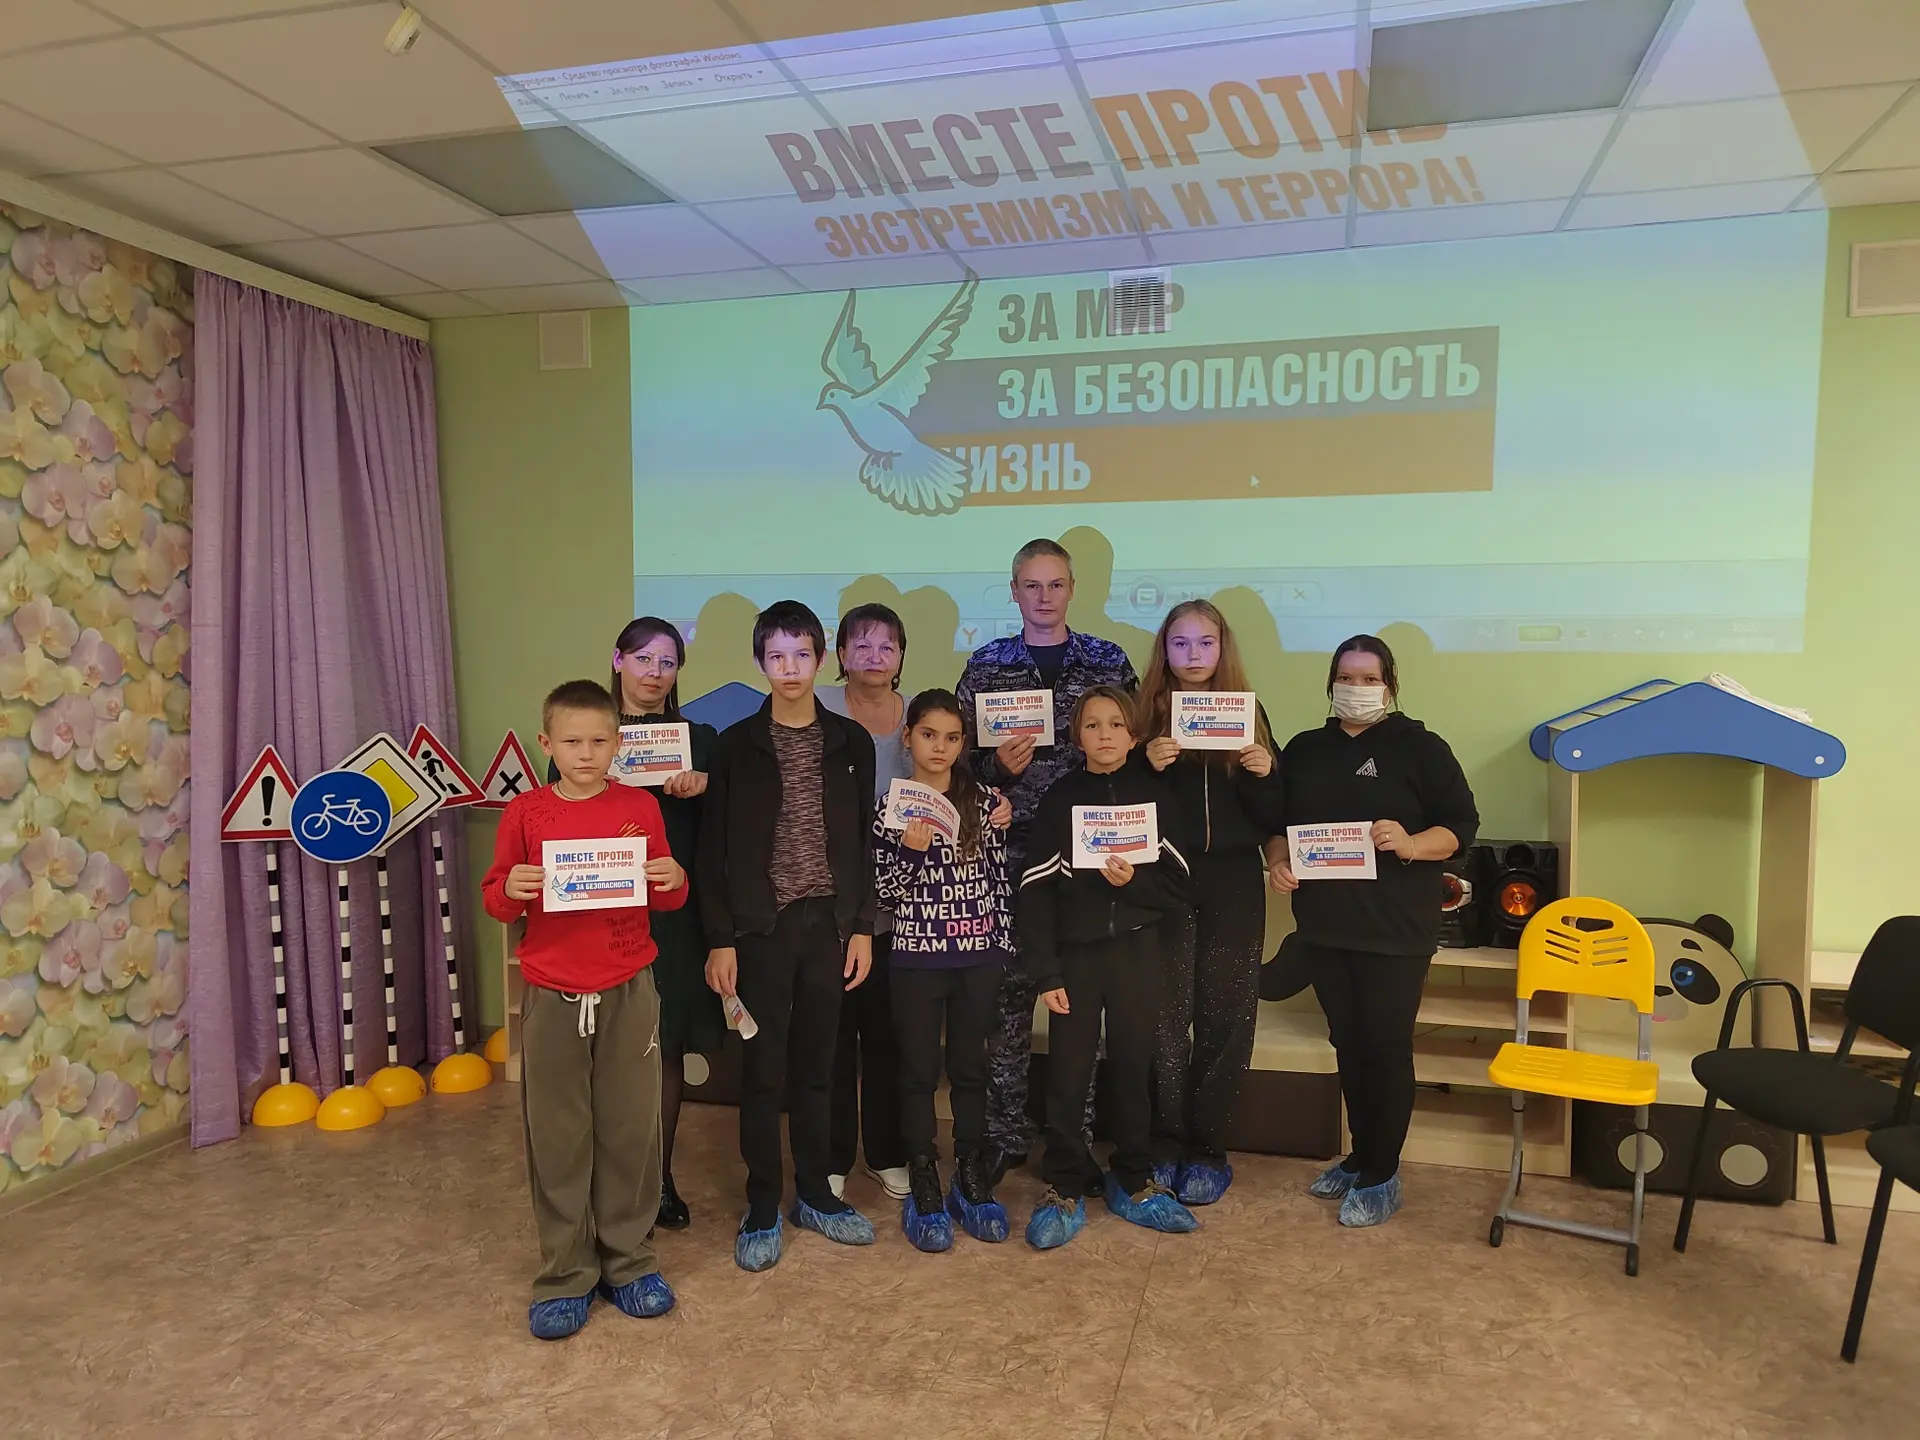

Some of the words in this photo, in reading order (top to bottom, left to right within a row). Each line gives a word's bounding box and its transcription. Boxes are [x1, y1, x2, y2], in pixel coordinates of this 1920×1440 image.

[562, 68, 601, 82] Средство
[649, 56, 701, 71] фотографий
[703, 52, 741, 63] Windows
[714, 71, 753, 83] Открыть
[765, 103, 1094, 203] ВМЕСТЕ
[814, 187, 1172, 258] ЭКСТРЕМИЗМА
[1171, 181, 1220, 228] И
[1218, 156, 1485, 223] ТЕРРОРА!
[998, 291, 1059, 344] ЗА
[998, 367, 1058, 419] ЗА
[1074, 343, 1481, 416] БЕЗОПАСНОСТЬ
[940, 441, 1091, 493] ИЗНЬ
[985, 697, 1014, 706] ВМЕСТЕ
[1016, 695, 1043, 704] ПРОТИВ
[1182, 697, 1212, 705] ВМЕСТЕ
[1215, 697, 1245, 705] ПРОТИВ
[623, 731, 648, 740] МЕСТЕ
[651, 729, 679, 738] ПРОТИВ
[848, 765, 855, 774] F
[900, 788, 931, 800] ВМЕСТЕ
[1083, 811, 1112, 820] ВМЕСТЕ
[1114, 810, 1146, 819] ПРОТИВ
[1298, 829, 1329, 838] ВМЕСТЕ
[1331, 828, 1362, 836] ПРОТИВ
[555, 852, 594, 863] ВМЕСТЕ
[597, 850, 634, 861] ПРОТИВ
[556, 863, 600, 871] ЭКСТРЕМИЗМА
[586, 881, 632, 890] БЕЗОПАСНОСТЬ
[903, 886, 933, 902] ELL
[921, 902, 972, 920] WELL
